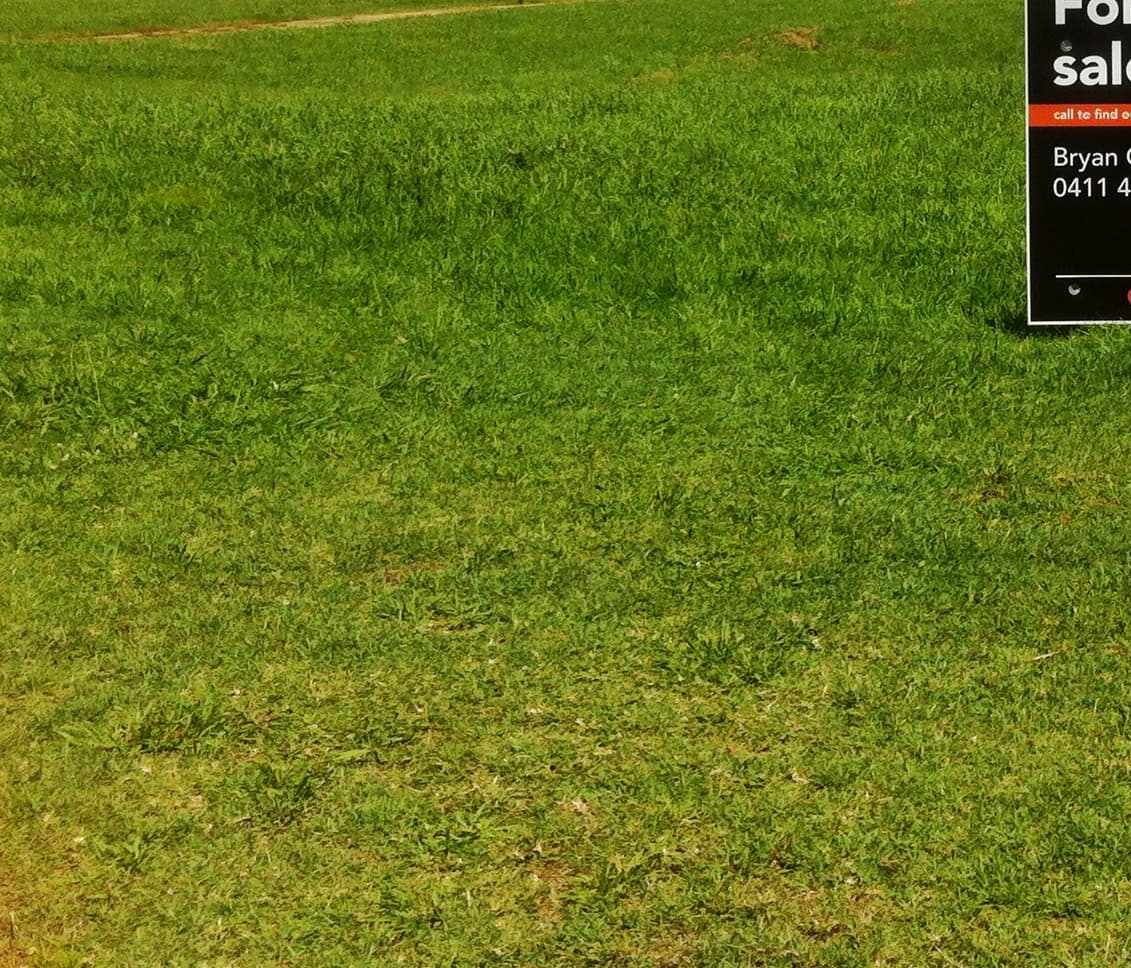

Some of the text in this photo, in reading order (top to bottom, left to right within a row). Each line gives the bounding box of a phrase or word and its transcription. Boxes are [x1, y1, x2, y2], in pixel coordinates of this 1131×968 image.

[1053, 108, 1074, 120] call
[1077, 109, 1091, 120] to
[1094, 107, 1119, 120] find
[1054, 147, 1118, 173] Bryan
[1053, 178, 1107, 198] 0411
